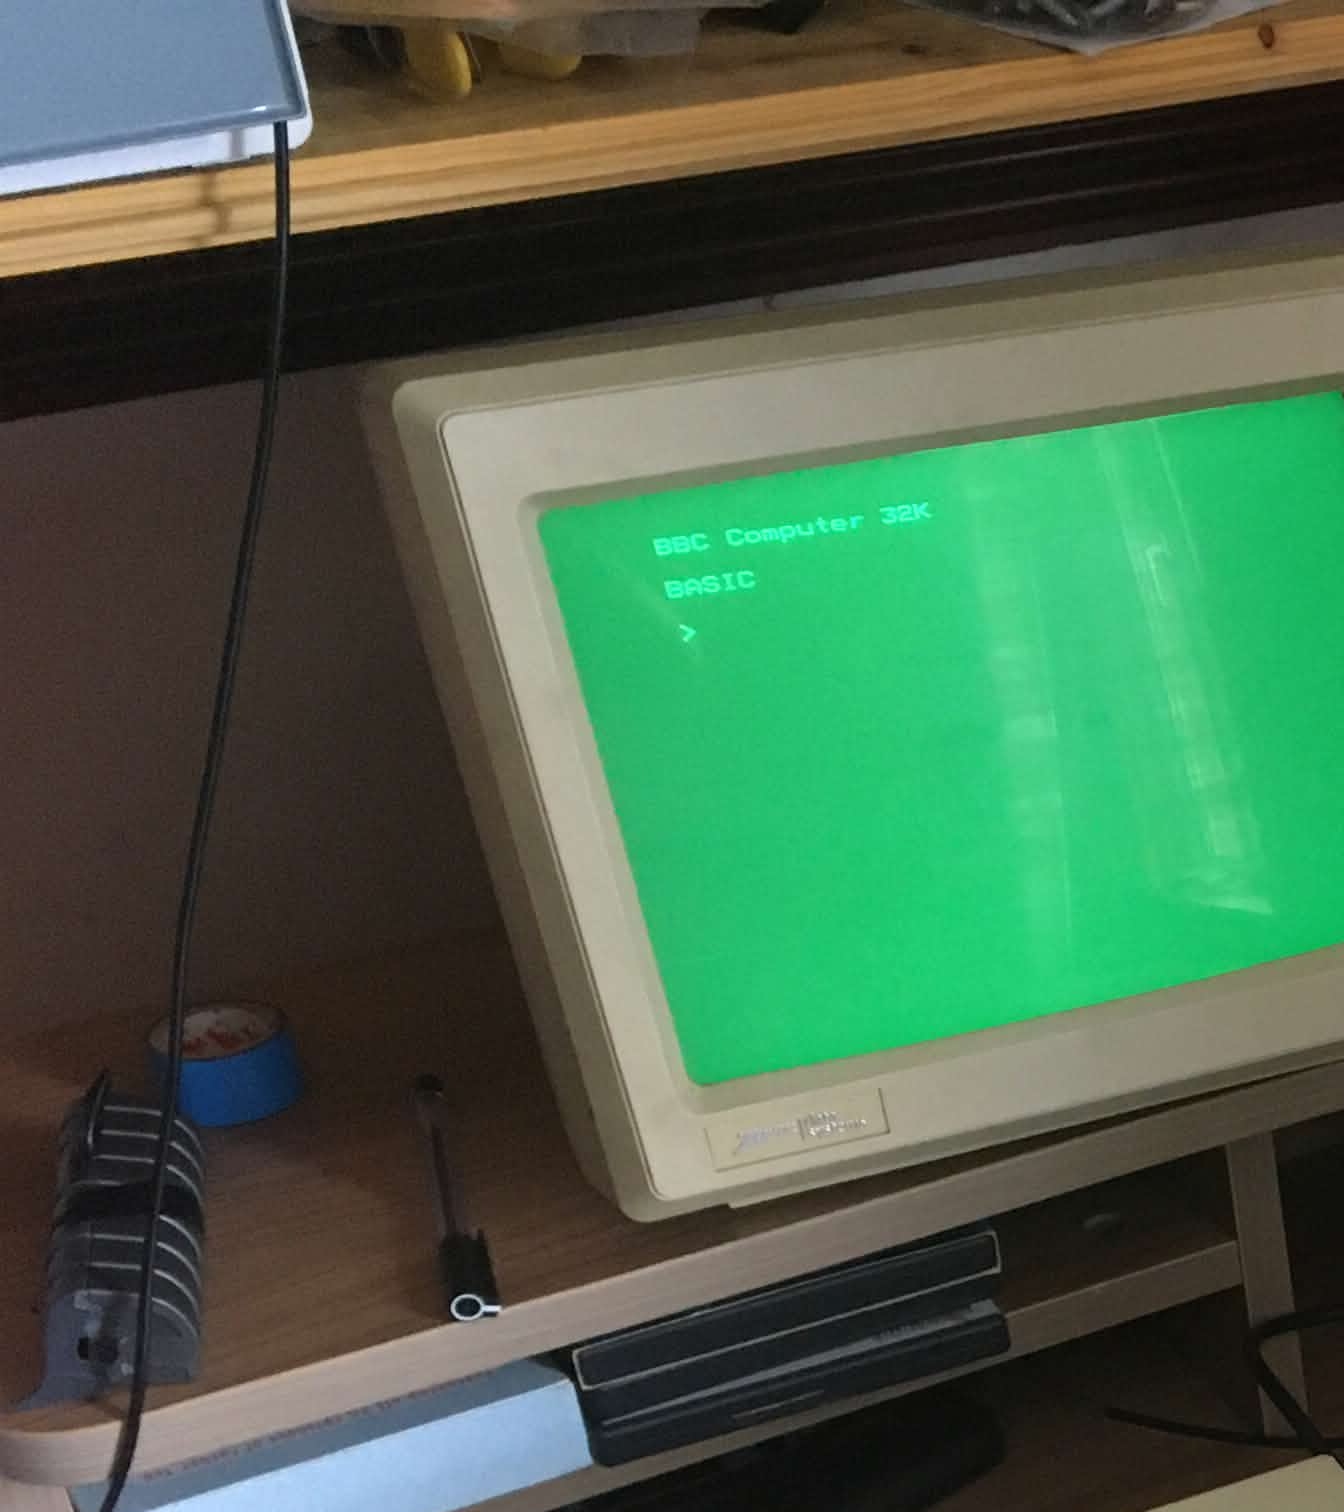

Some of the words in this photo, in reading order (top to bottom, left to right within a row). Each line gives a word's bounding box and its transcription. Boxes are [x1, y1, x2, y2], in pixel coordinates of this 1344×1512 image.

[653, 533, 711, 556] BBC
[725, 515, 864, 546] Computer
[879, 502, 934, 525] 32K
[663, 571, 756, 599] BASIC
